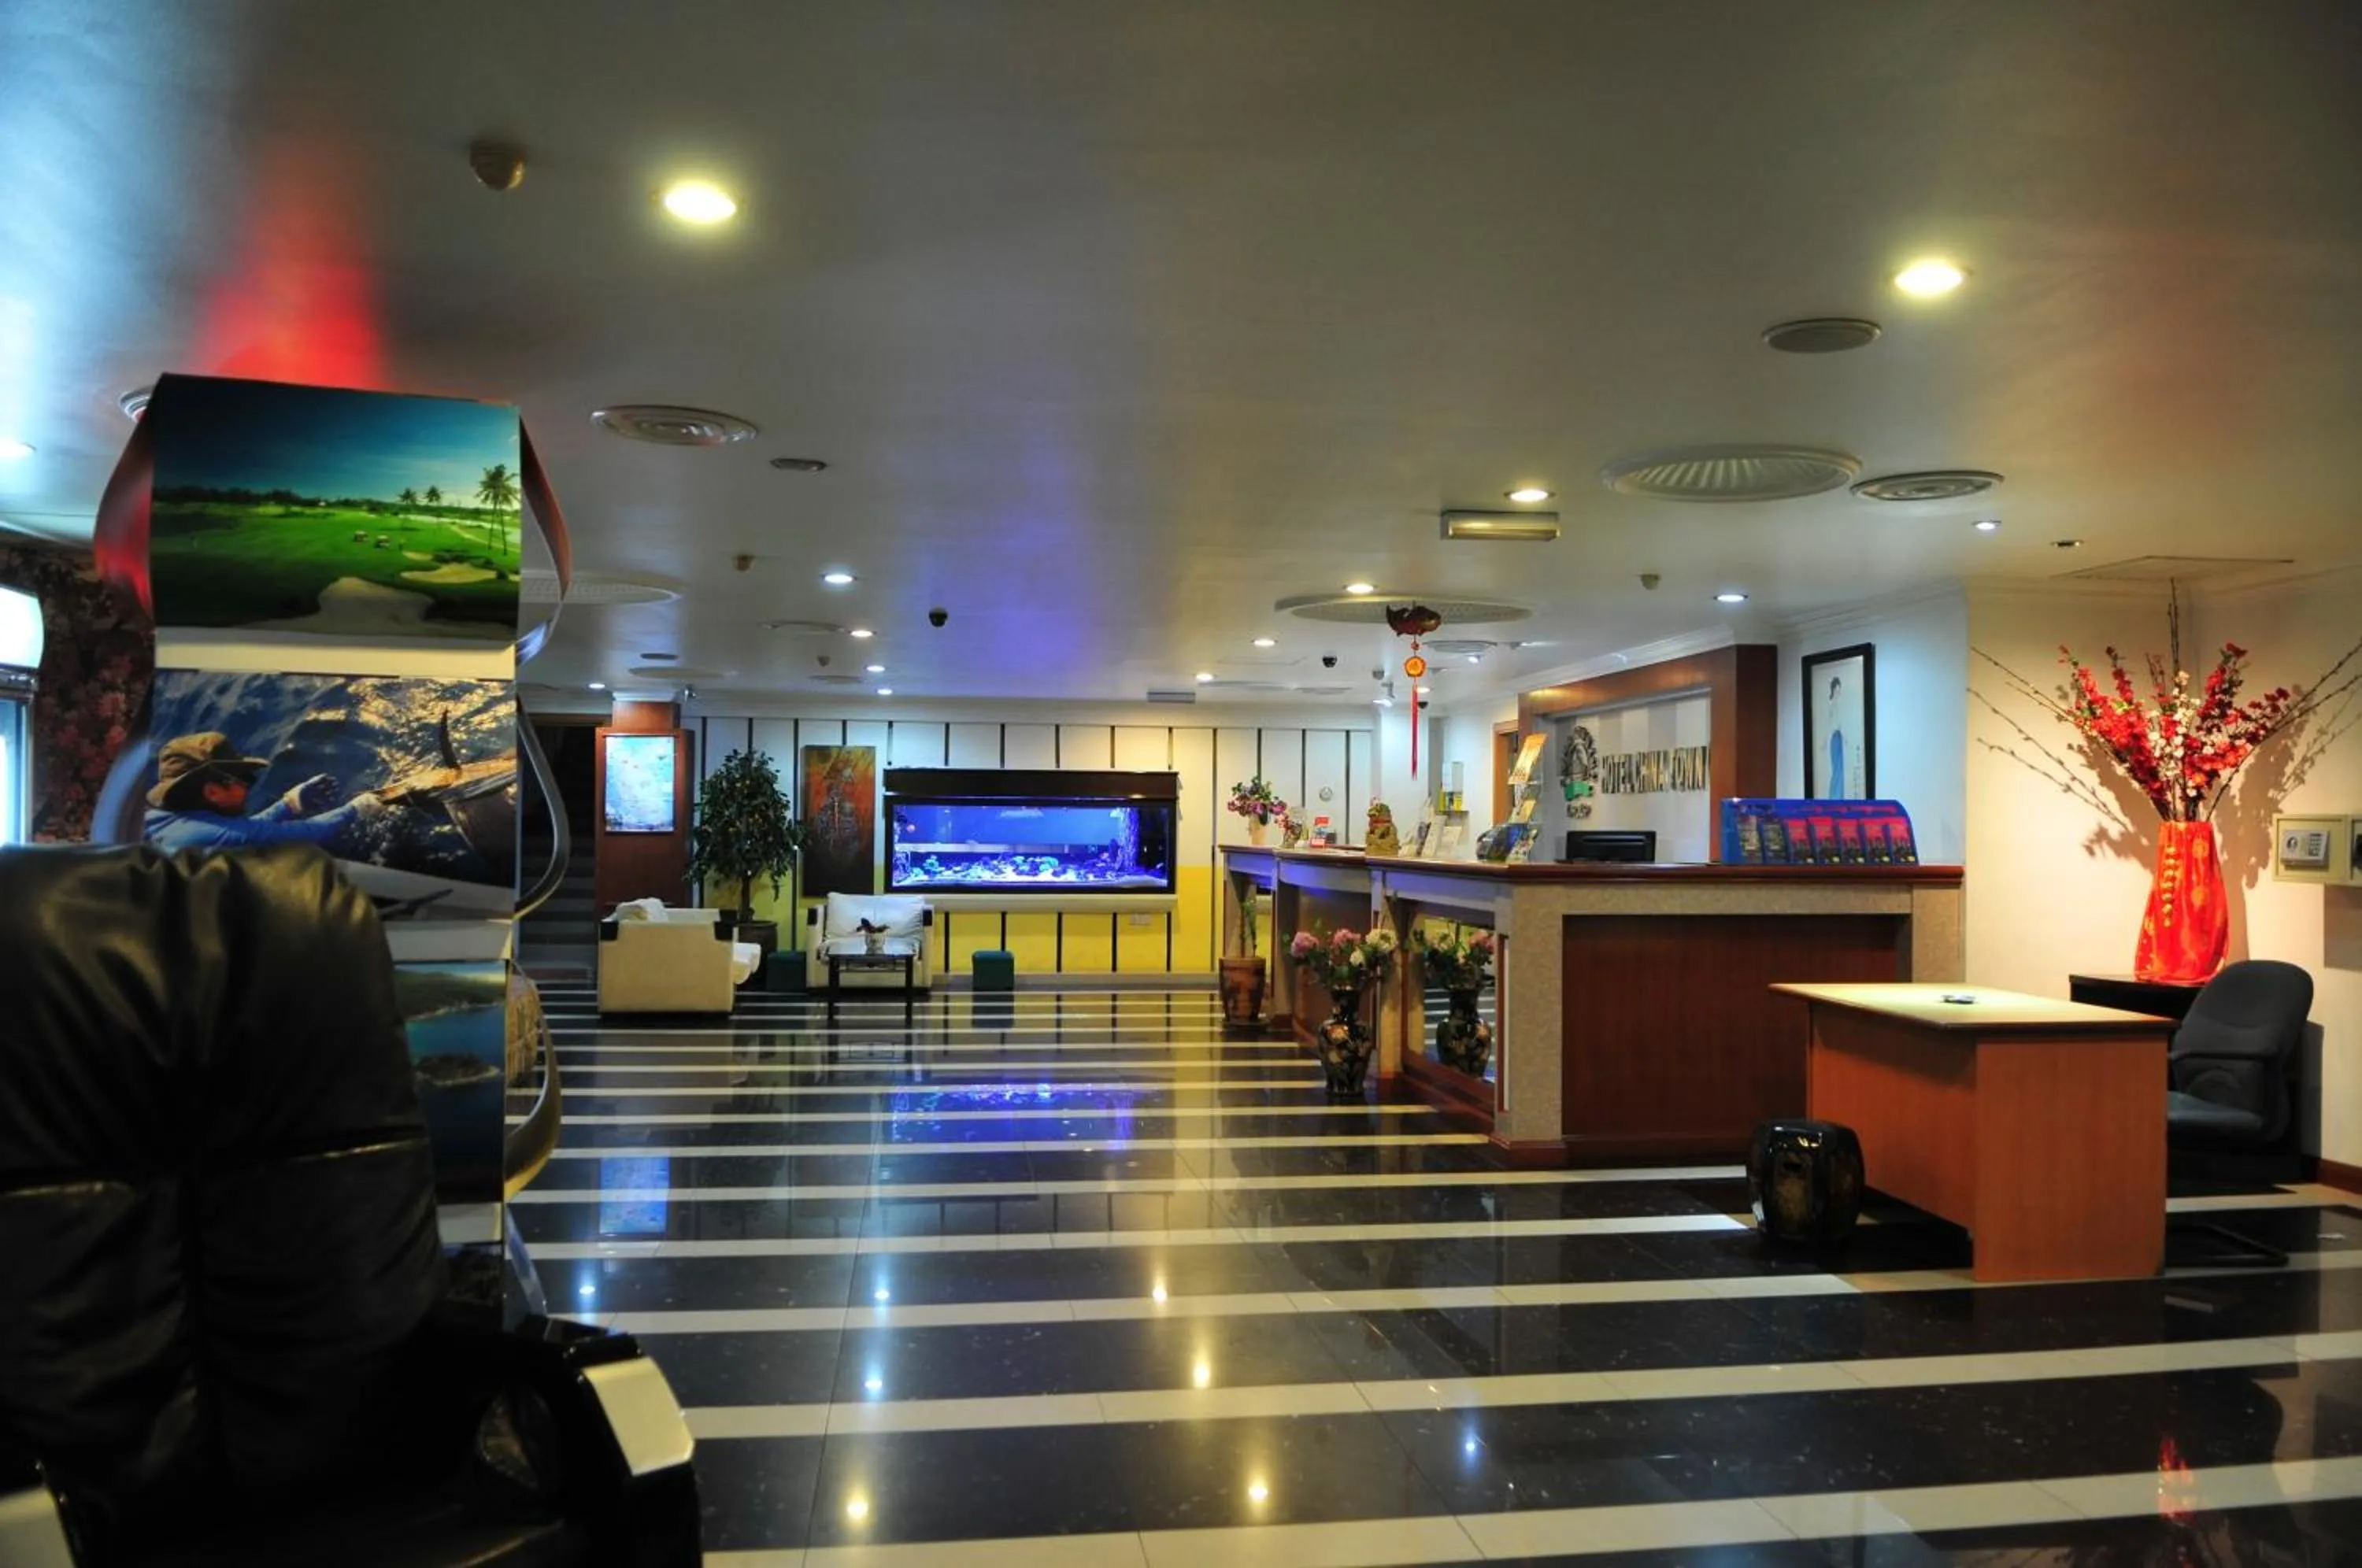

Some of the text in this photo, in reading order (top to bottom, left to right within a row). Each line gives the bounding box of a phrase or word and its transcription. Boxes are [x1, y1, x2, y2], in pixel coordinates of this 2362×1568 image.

[1601, 746, 1707, 794] HOTEL CHINA TOWN
